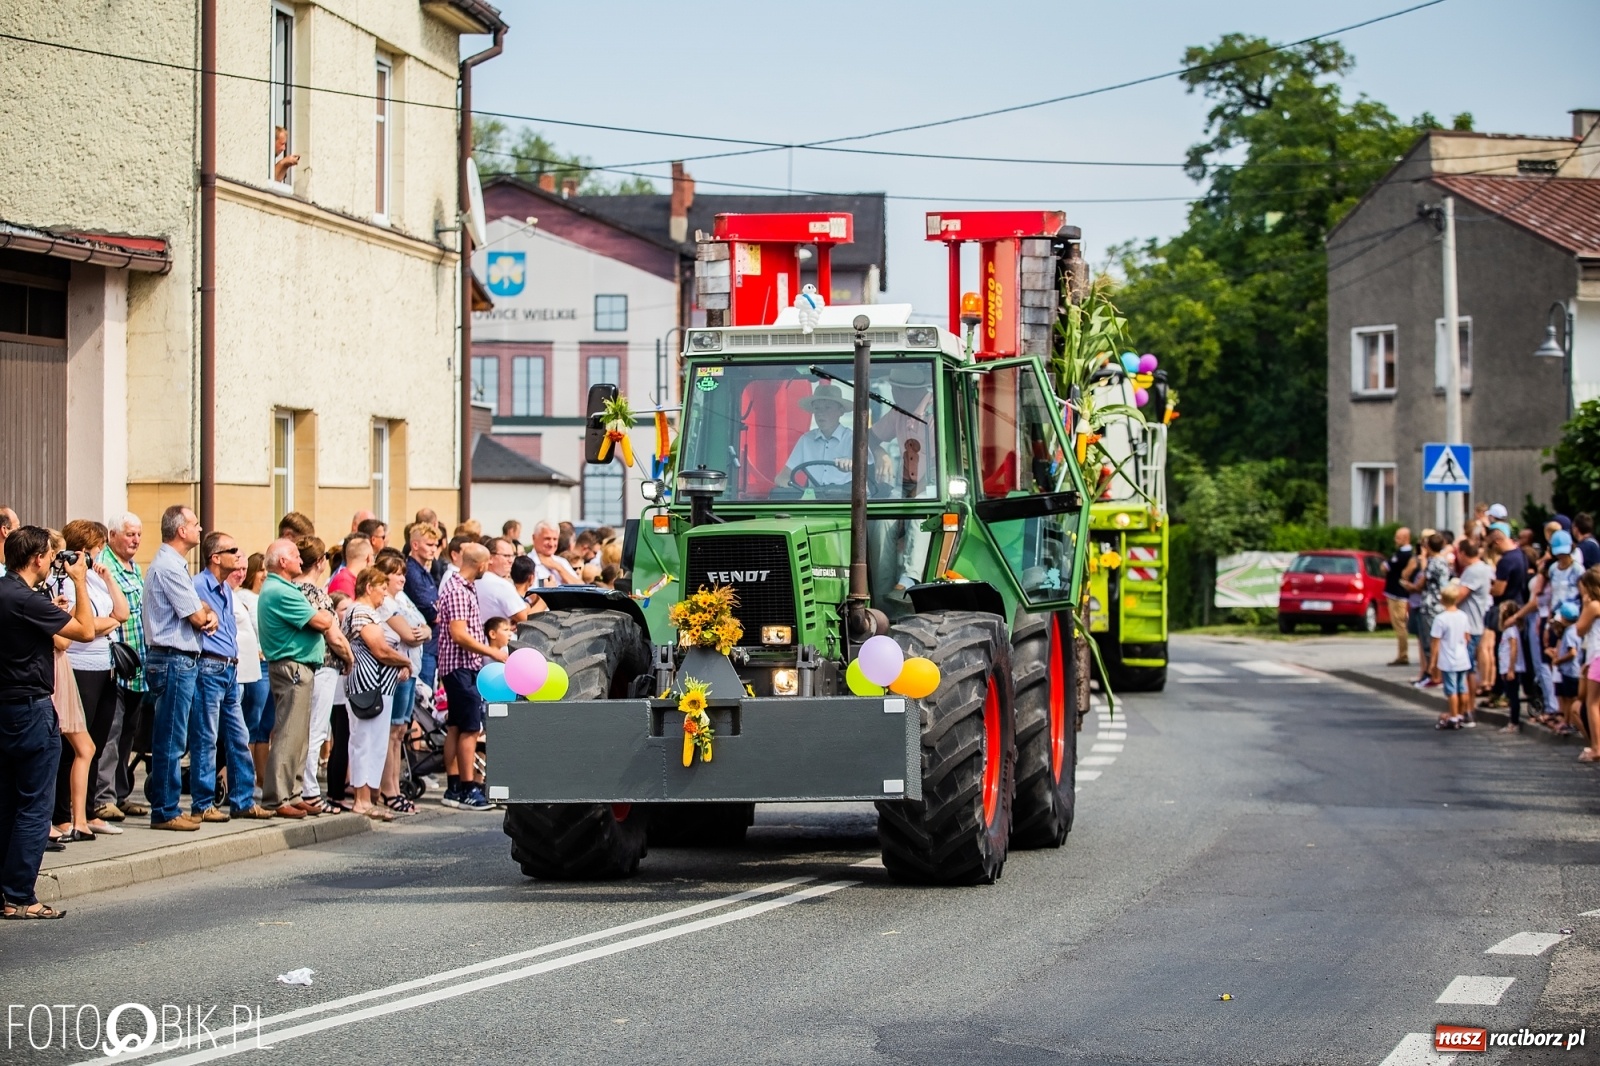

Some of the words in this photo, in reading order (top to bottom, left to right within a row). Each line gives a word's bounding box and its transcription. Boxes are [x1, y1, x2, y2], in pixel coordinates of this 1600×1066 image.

[988, 261, 996, 274] P
[522, 308, 578, 320] WIELKIE
[987, 277, 996, 339] CUNEO
[706, 570, 771, 583] FENDT
